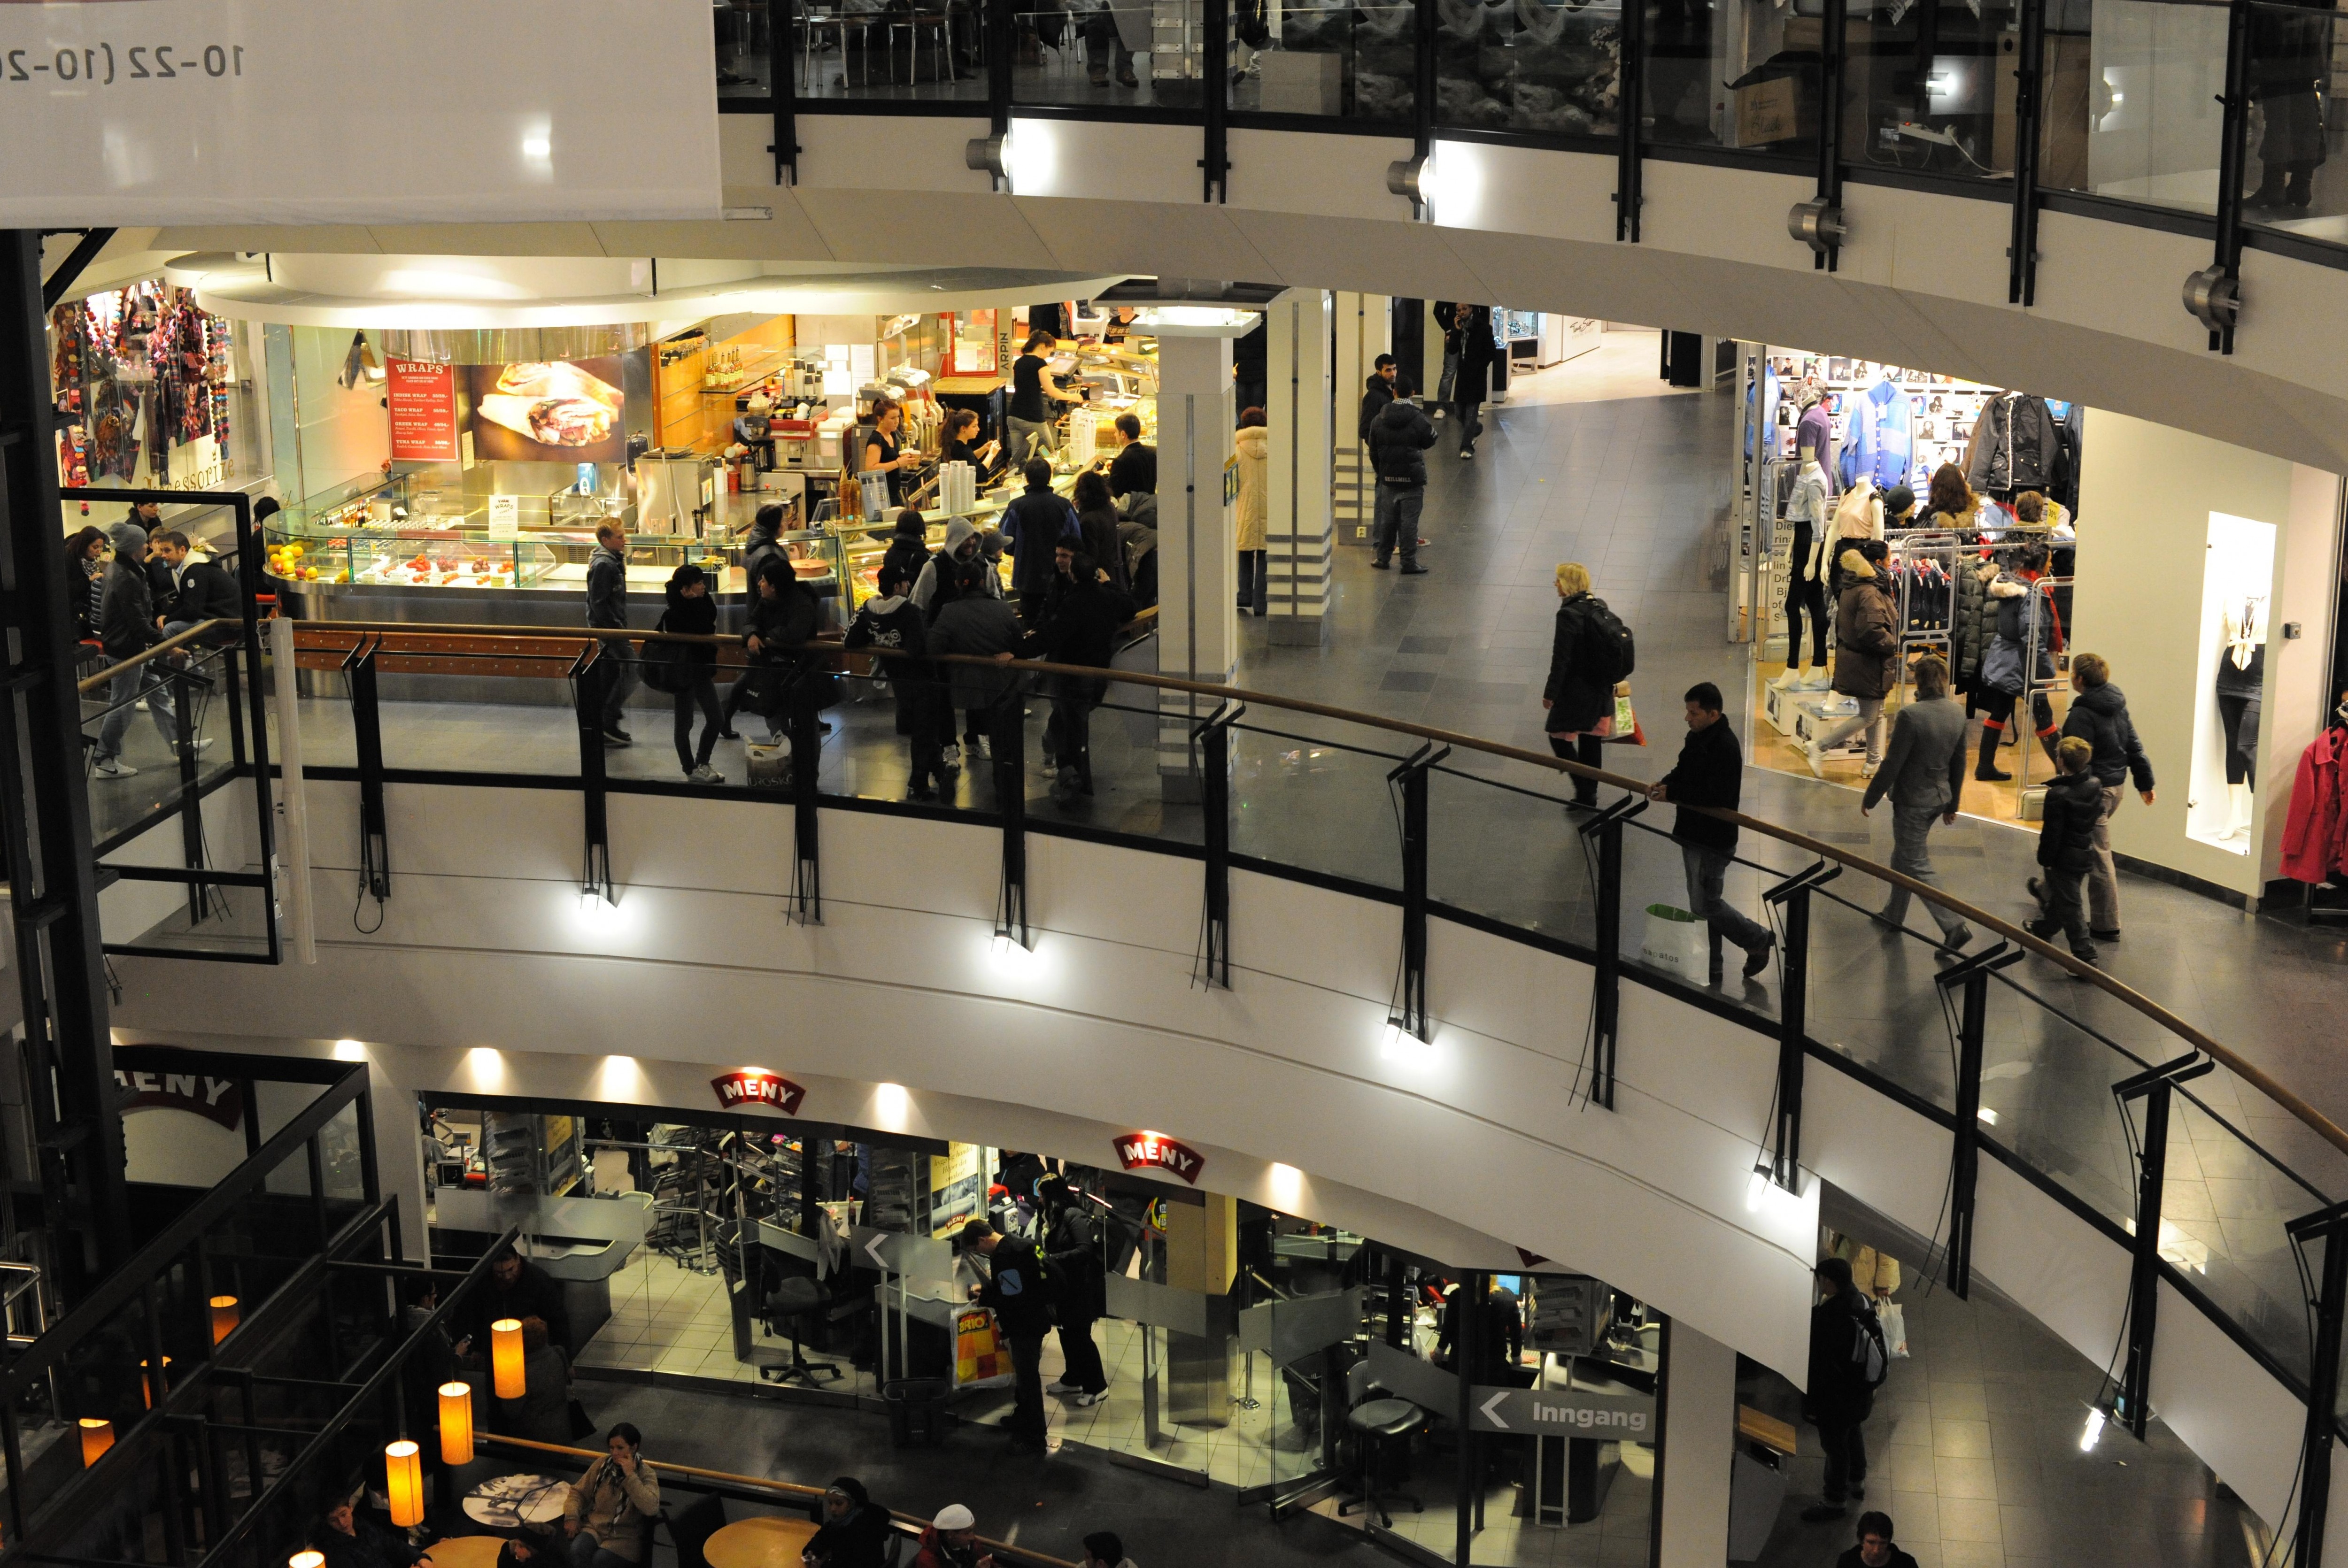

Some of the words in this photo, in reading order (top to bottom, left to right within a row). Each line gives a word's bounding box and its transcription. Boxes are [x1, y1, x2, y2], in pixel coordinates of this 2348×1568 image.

[396, 363, 443, 374] WRAPS
[1643, 948, 1679, 963] sapatos
[722, 1079, 795, 1104] MENY
[1123, 1141, 1194, 1171] MENY
[947, 1215, 965, 1227] MENY
[959, 1316, 985, 1333] BRIO
[1533, 1402, 1646, 1431] Inngang
